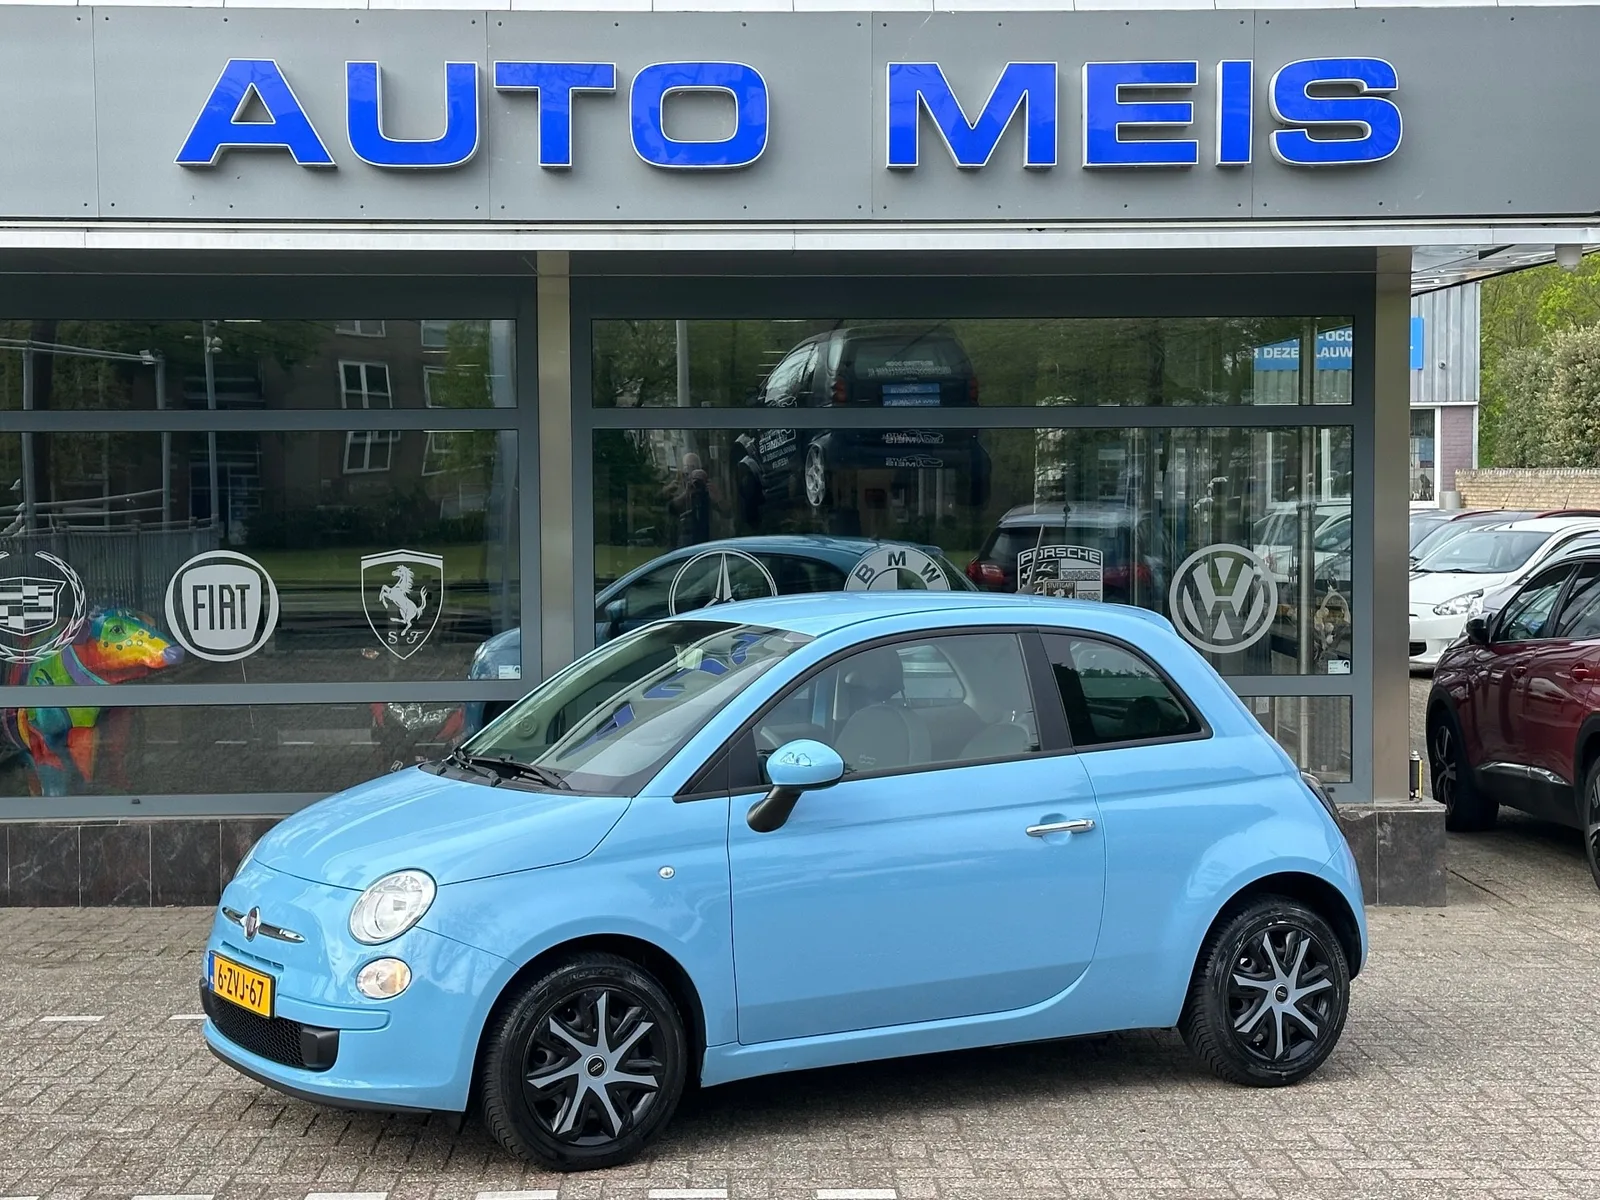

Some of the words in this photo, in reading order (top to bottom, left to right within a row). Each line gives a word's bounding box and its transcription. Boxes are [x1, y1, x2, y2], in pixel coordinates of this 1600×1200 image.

[173, 58, 771, 169] AUTO
[885, 57, 1404, 168] MEIS
[192, 583, 252, 631] FIAT
[217, 964, 265, 1008] 6-ZVJ-67
